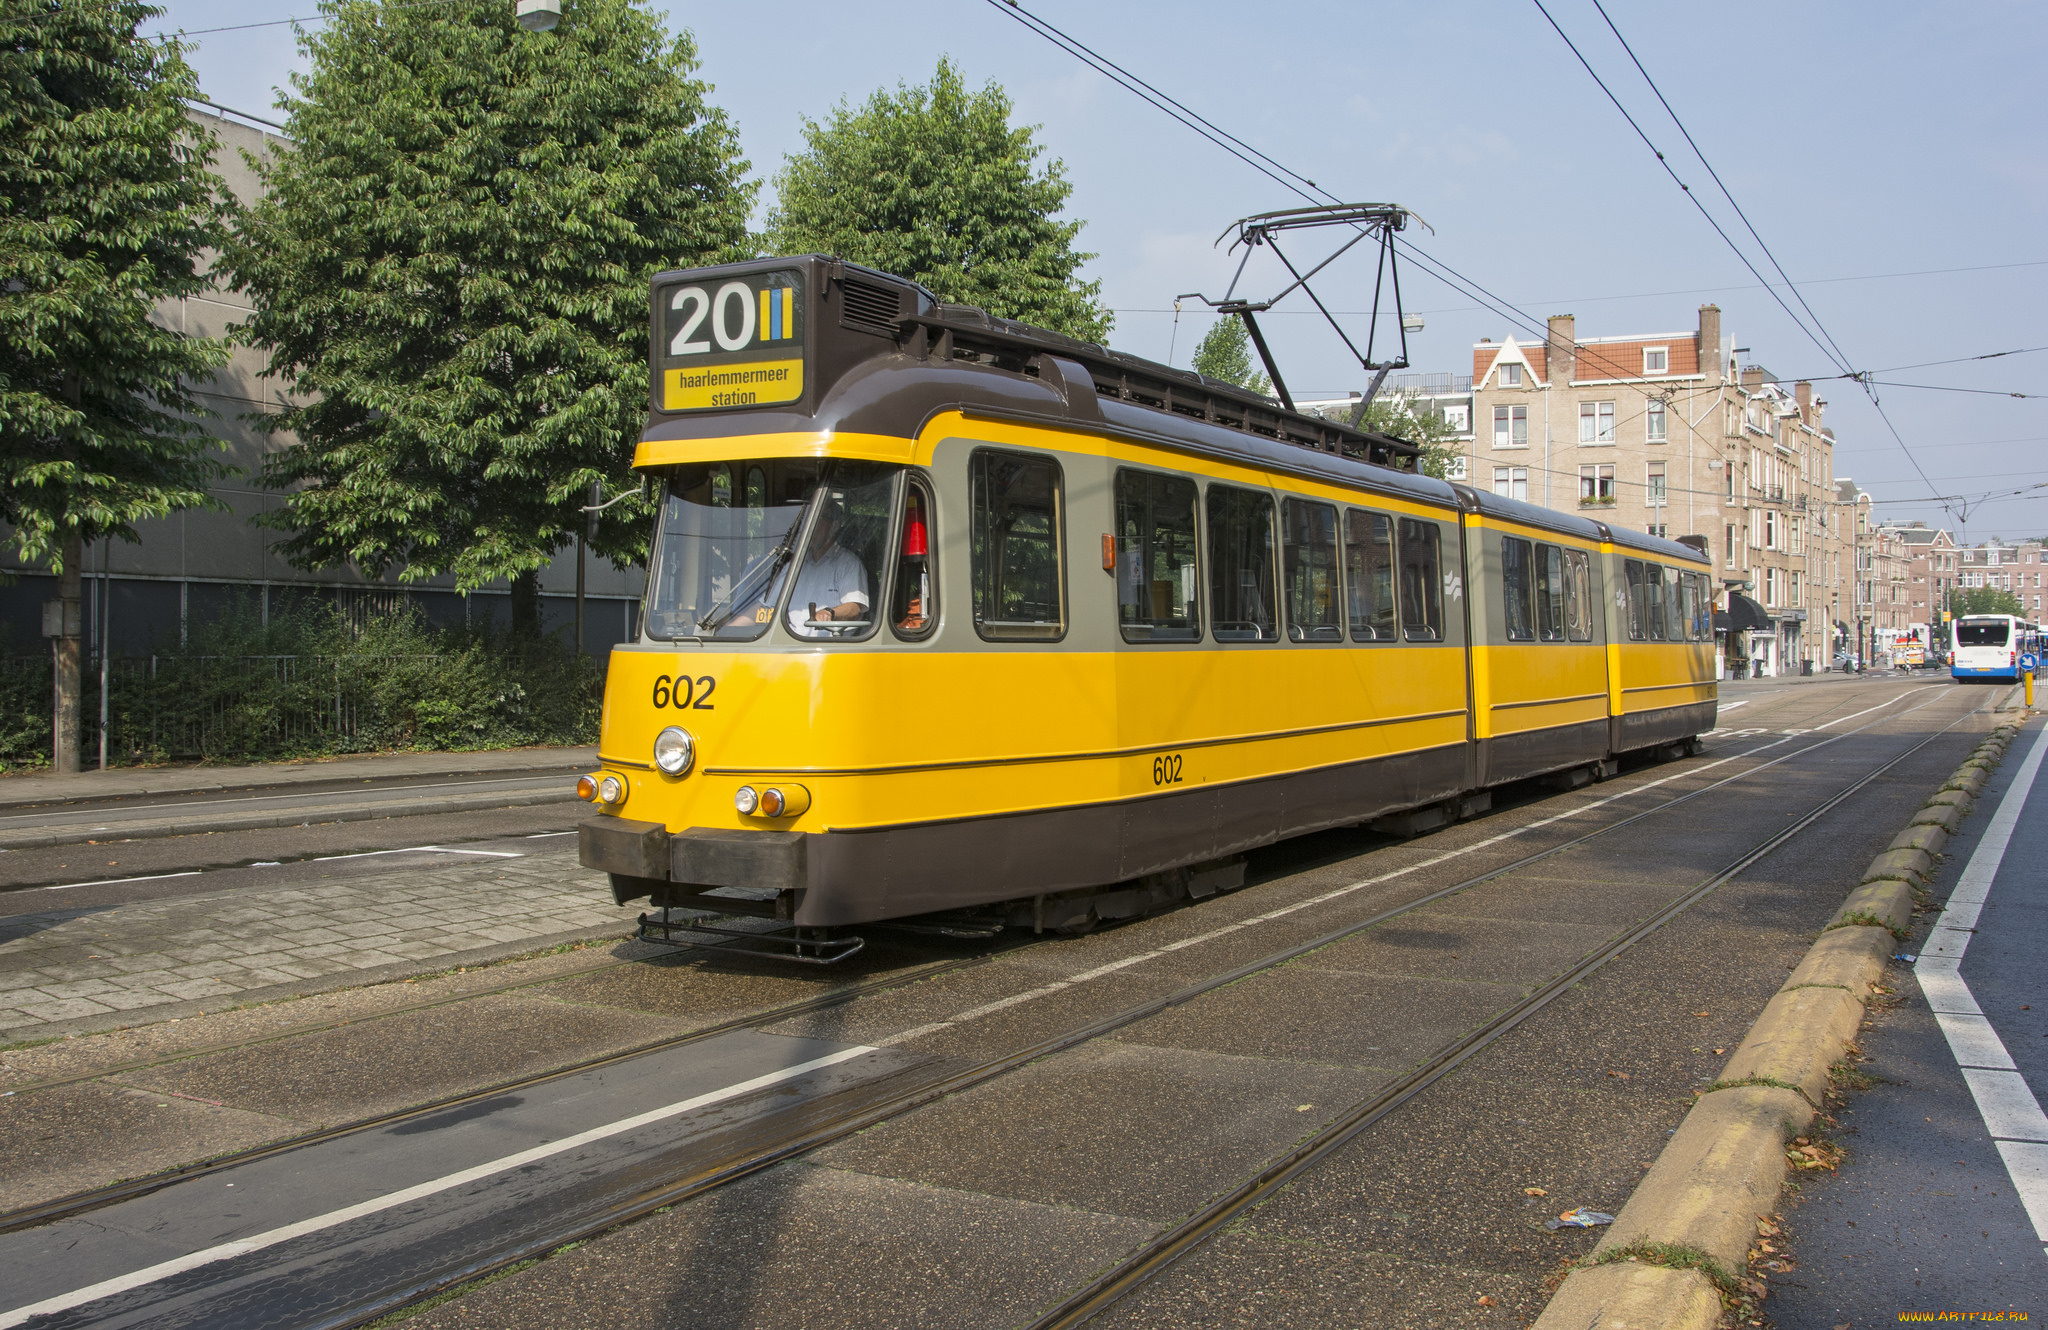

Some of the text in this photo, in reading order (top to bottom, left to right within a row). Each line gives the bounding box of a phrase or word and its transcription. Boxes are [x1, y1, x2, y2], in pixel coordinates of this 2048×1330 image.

[670, 281, 756, 356] 20
[680, 368, 789, 389] haarlemmermeer
[711, 388, 756, 407] station
[652, 674, 716, 711] 602
[1153, 754, 1183, 786] 602
